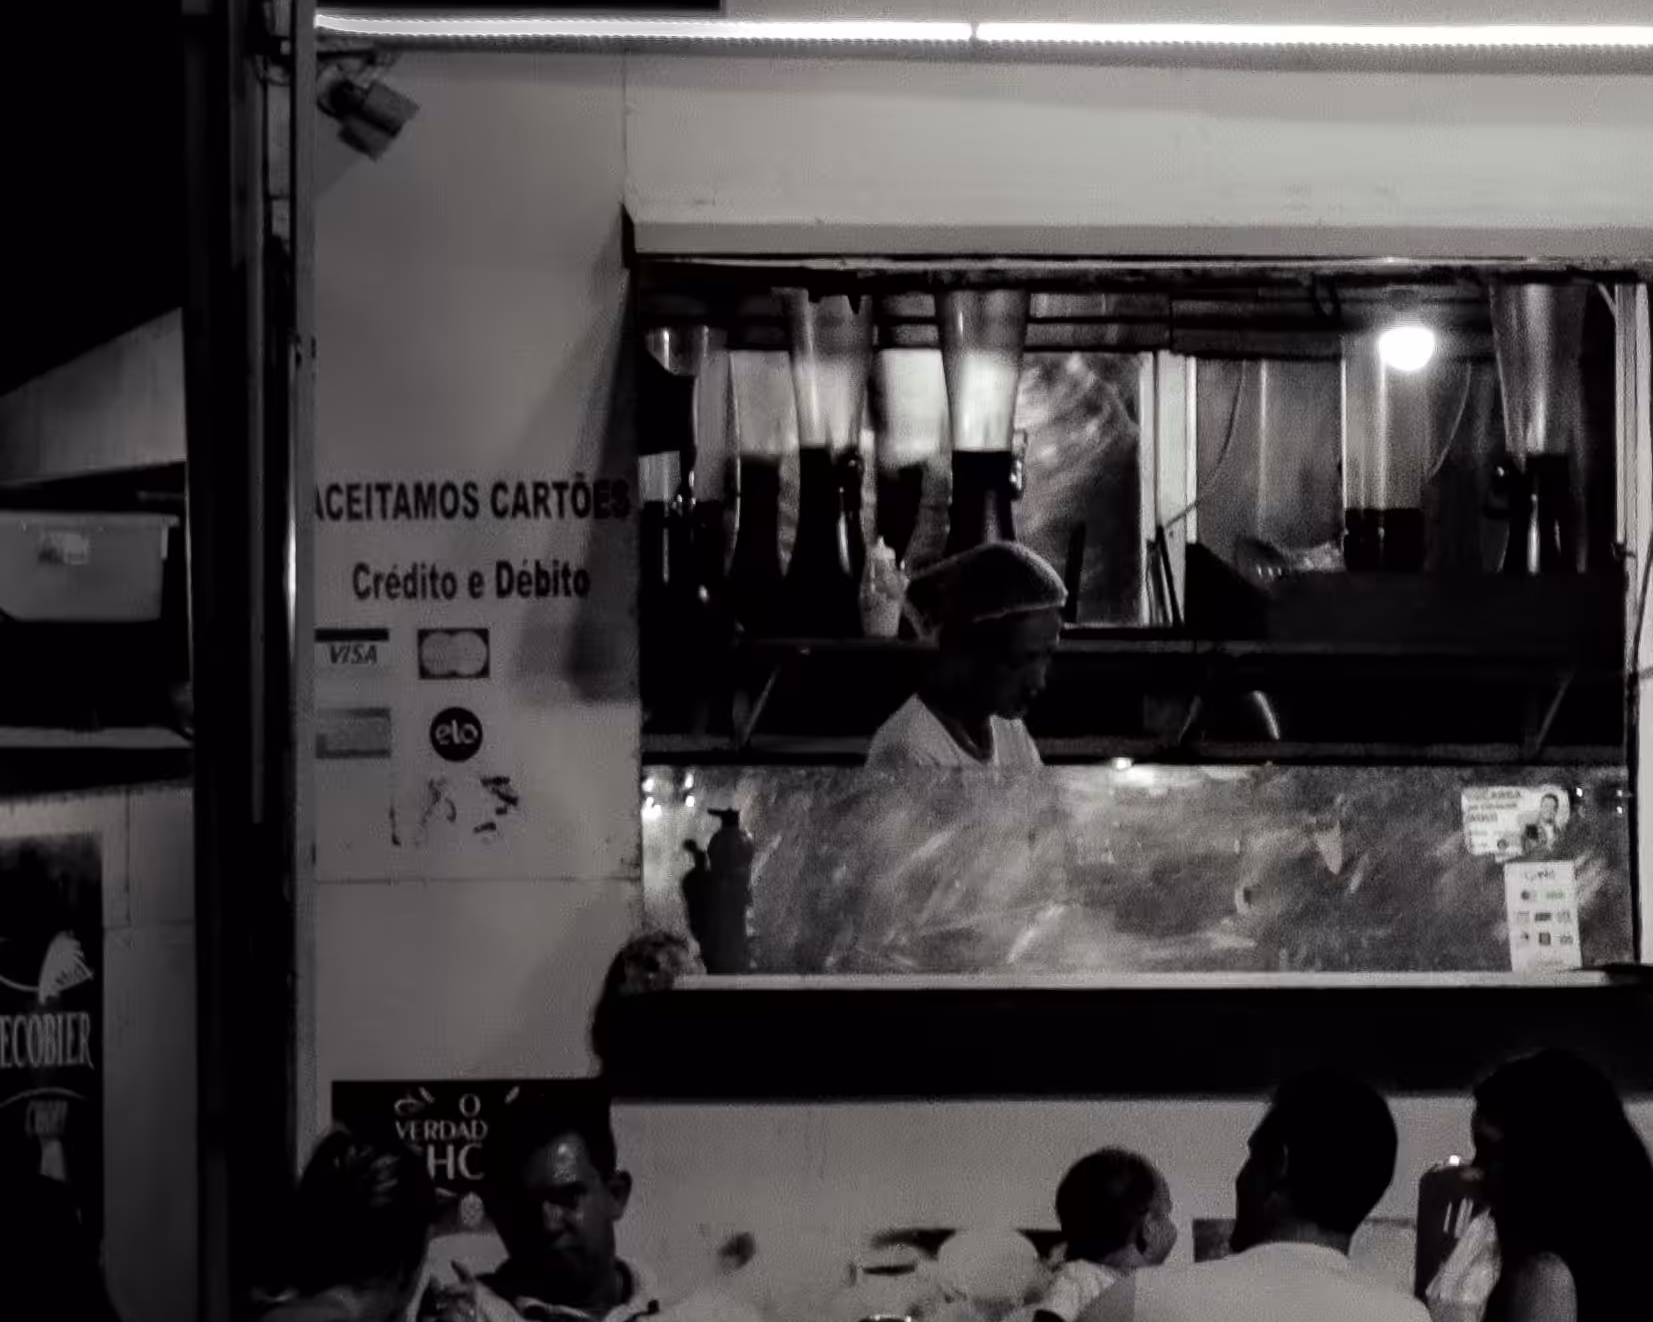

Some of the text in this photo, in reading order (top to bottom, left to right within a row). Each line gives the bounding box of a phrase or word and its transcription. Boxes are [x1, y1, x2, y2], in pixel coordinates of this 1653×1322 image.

[490, 472, 632, 521] CARTÕES
[352, 559, 592, 600] Crédito e Débito
[329, 643, 378, 665] VISA
[434, 718, 480, 746] elo
[0, 1011, 95, 1070] ECOBIER
[457, 1093, 482, 1118] O
[394, 1117, 491, 1142] VERDAD
